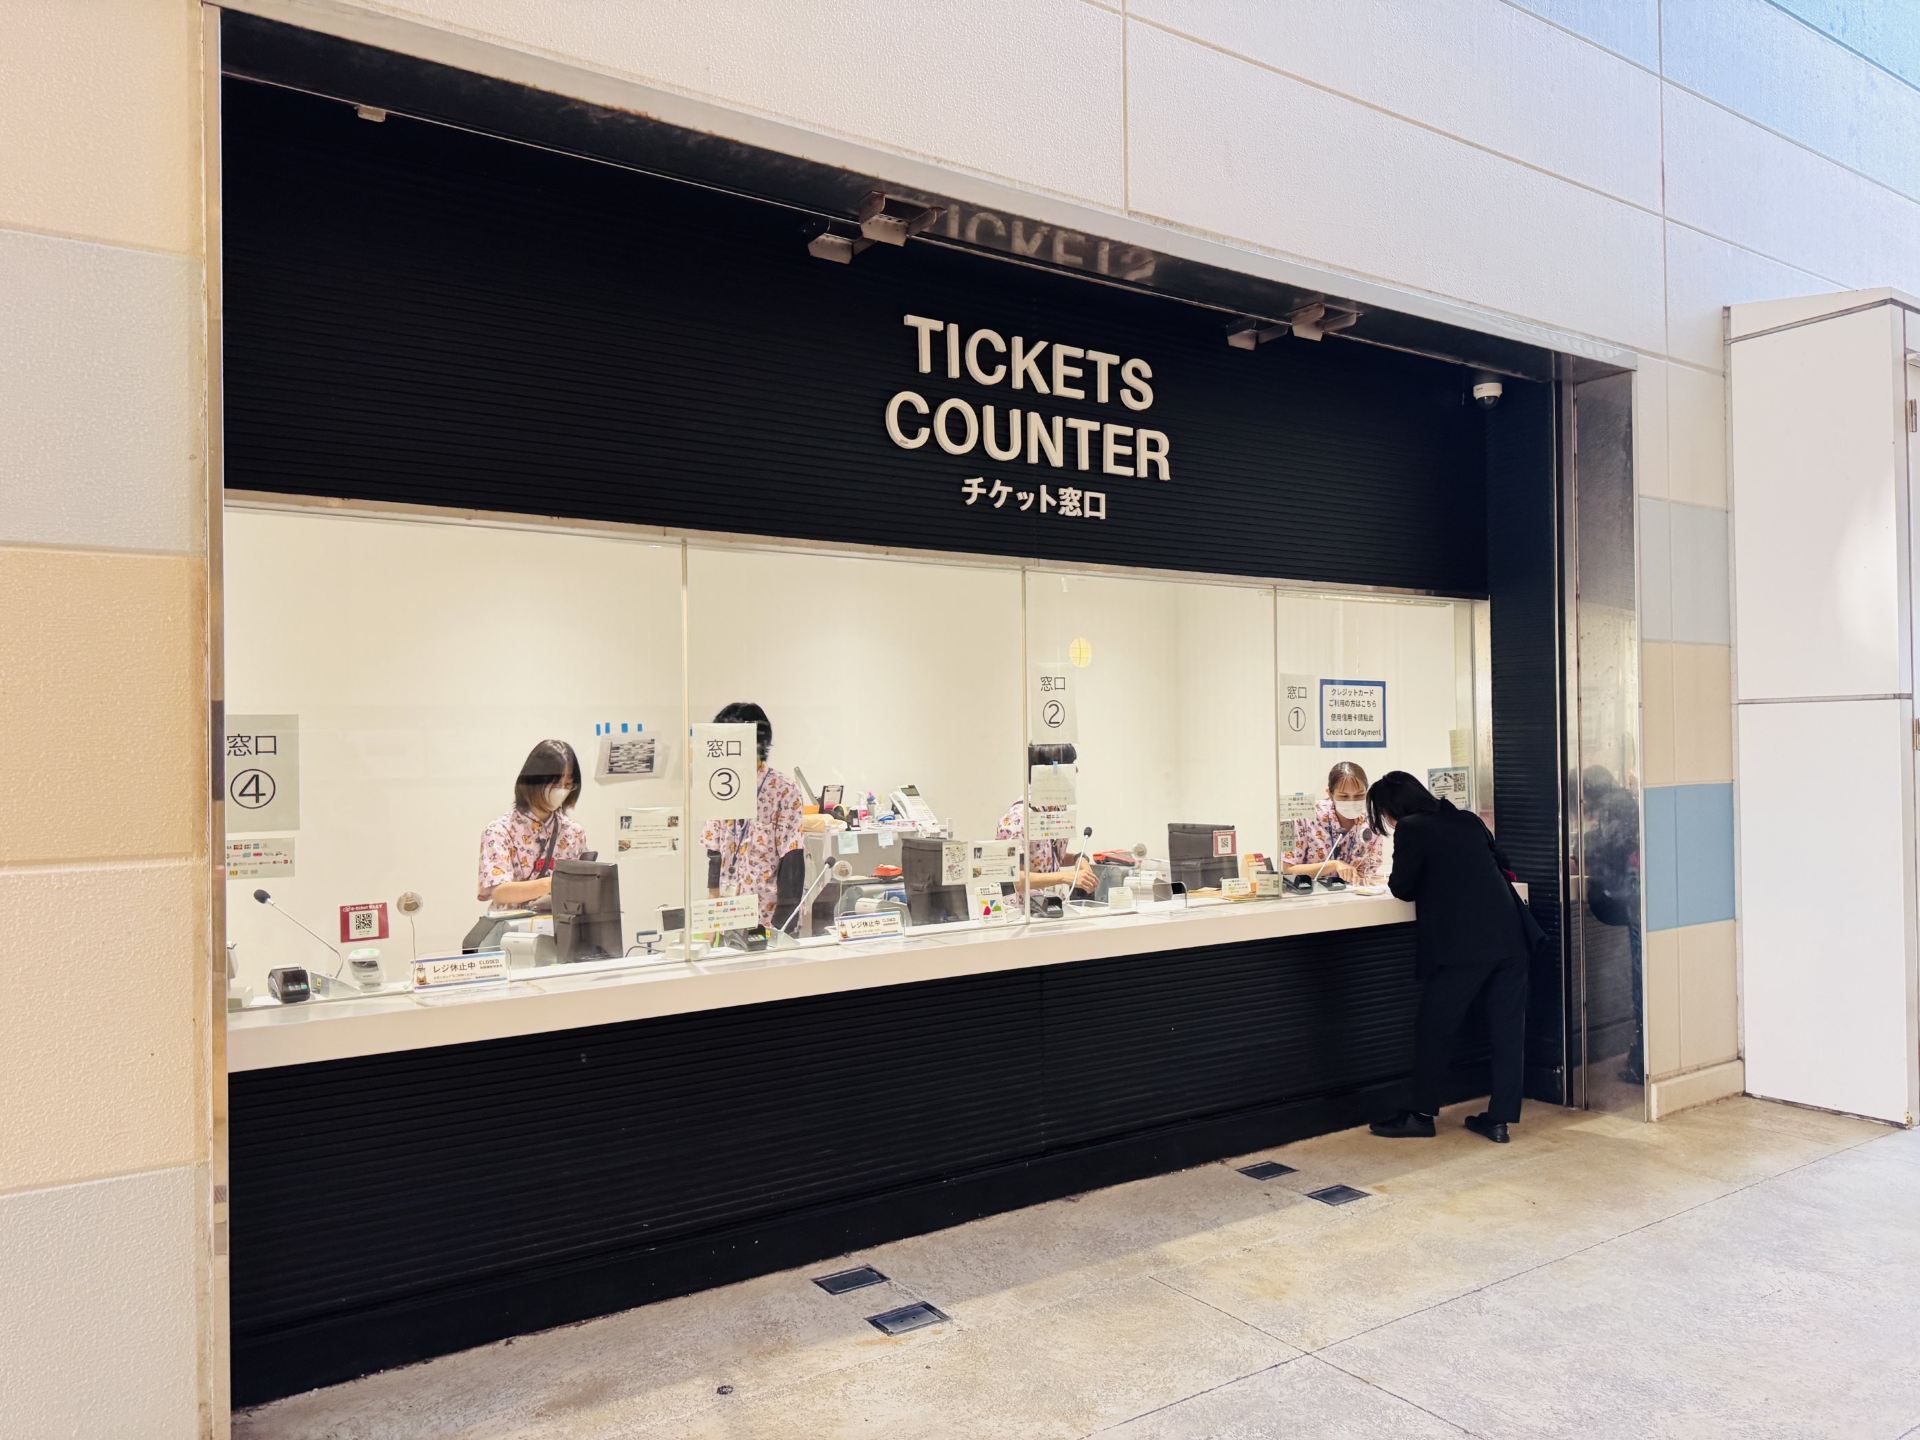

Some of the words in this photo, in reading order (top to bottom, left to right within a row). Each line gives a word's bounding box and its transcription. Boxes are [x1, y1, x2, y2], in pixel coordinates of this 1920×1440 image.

[903, 314, 1154, 411] TICKETS
[885, 390, 1171, 481] COUNTER
[961, 477, 1107, 520] チケット窓口
[1040, 676, 1066, 692] 窓口
[1286, 686, 1307, 699] 窓口
[1331, 688, 1374, 697] クレジットカード
[1328, 699, 1377, 708] ご利用の方はこちら
[1325, 728, 1343, 736] Credit
[1343, 728, 1357, 736] Card
[1357, 728, 1381, 737] Payment
[226, 733, 277, 757] 窓口
[706, 739, 742, 758] 窓口
[433, 961, 476, 974] レジ休止中
